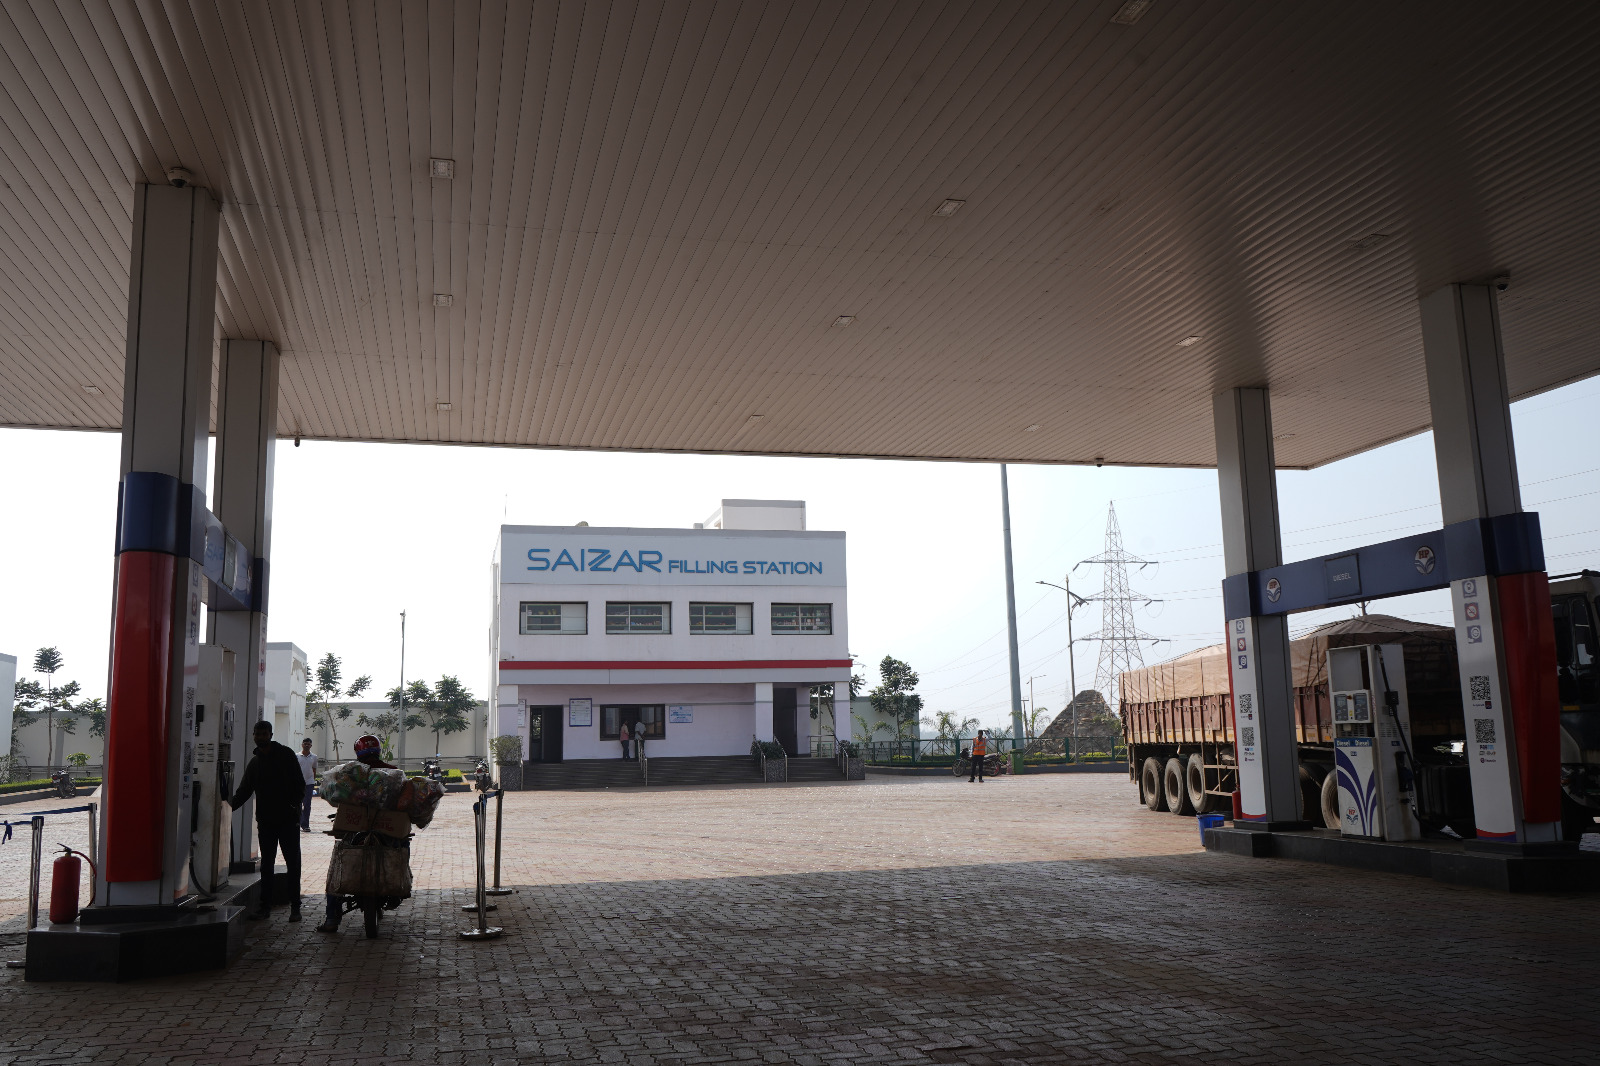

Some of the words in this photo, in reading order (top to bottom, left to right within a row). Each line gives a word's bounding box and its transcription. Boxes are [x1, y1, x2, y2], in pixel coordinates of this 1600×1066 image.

[1418, 549, 1430, 560] HP
[668, 560, 738, 574] FILLING
[743, 560, 823, 575] STATION
[1332, 572, 1352, 582] DIESEL
[1348, 808, 1356, 816] HP
